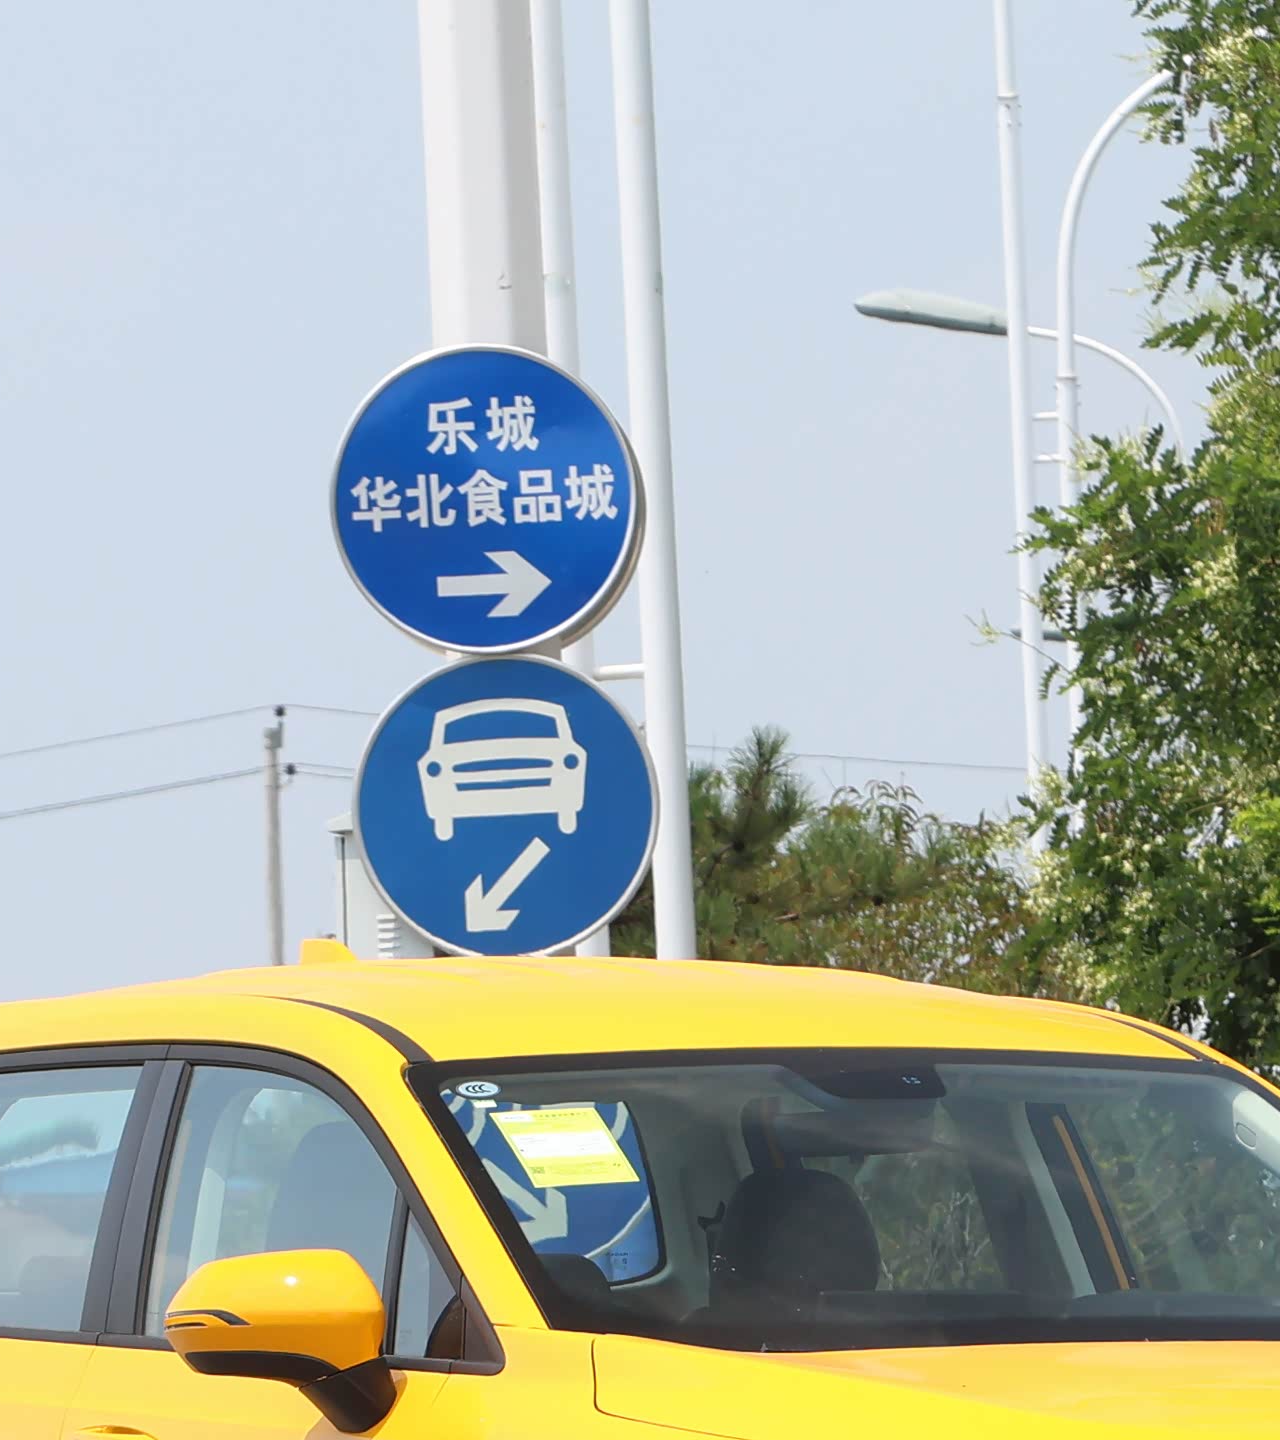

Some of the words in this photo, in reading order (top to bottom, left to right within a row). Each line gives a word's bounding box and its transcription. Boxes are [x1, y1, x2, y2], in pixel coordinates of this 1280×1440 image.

[426, 395, 540, 456] 乐城
[350, 464, 619, 533] 华北食品城
